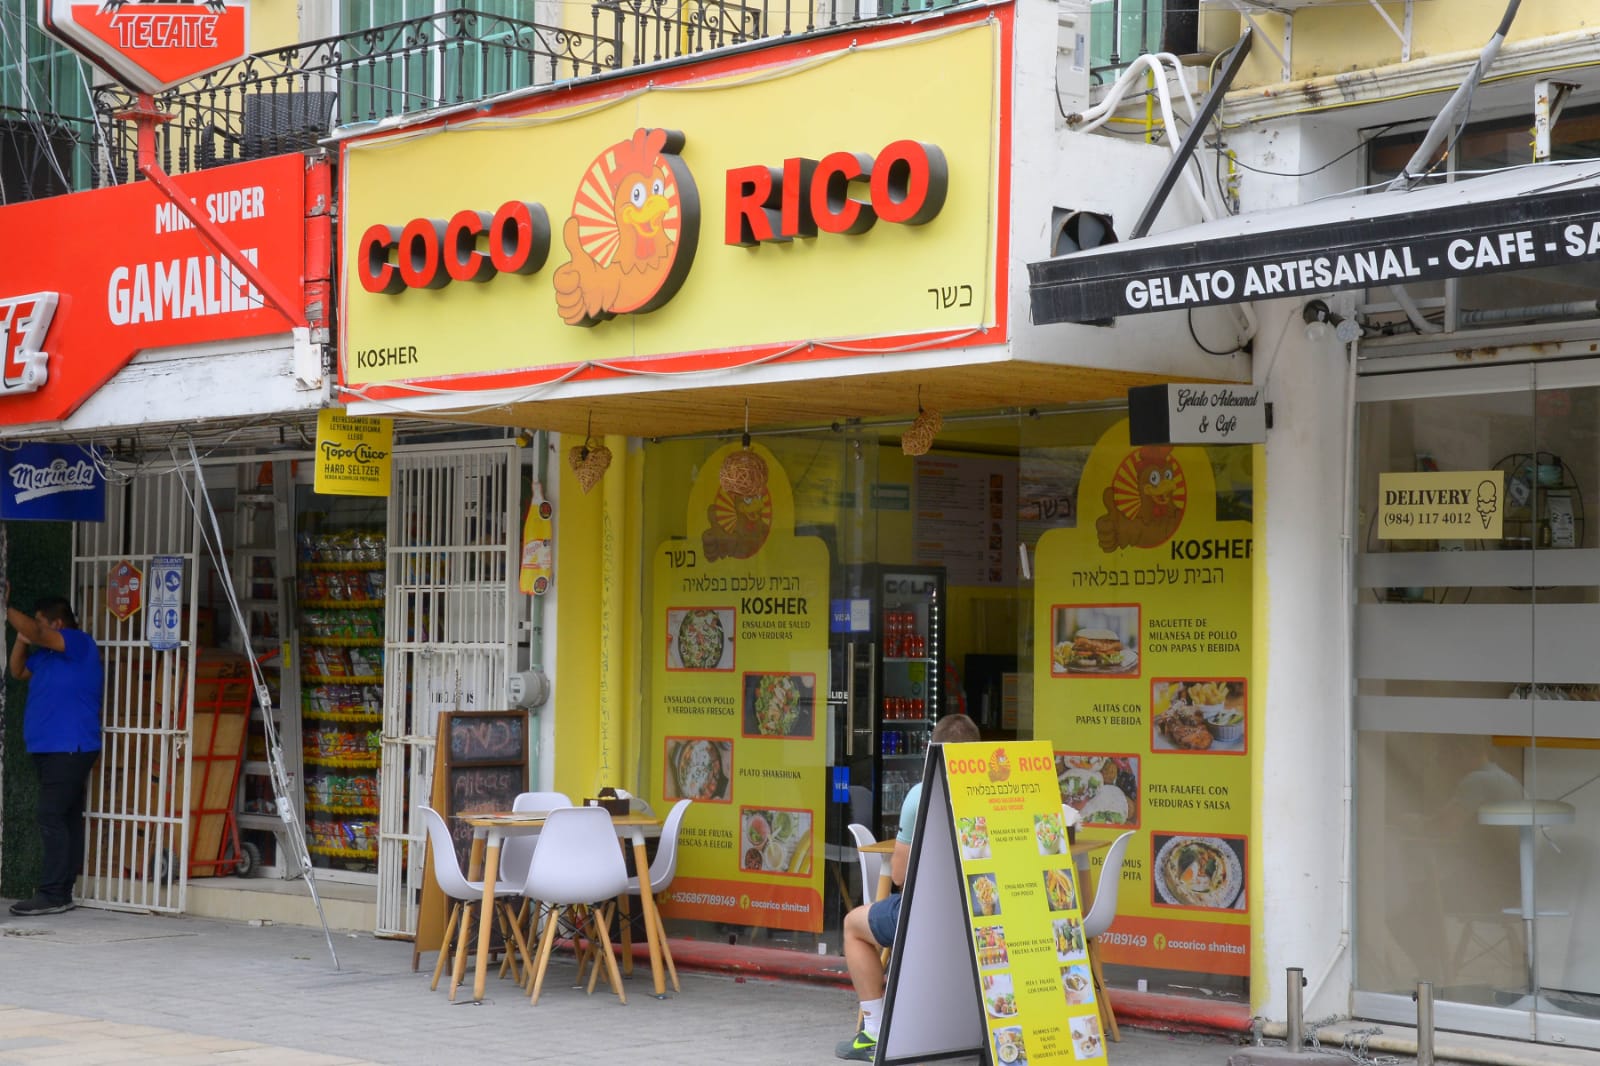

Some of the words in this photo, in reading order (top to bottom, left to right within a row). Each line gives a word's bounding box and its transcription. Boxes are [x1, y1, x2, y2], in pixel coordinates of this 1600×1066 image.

[110, 14, 218, 48] TECATE
[206, 186, 265, 224] SUPER
[358, 200, 551, 295] COCO
[725, 139, 948, 248] RICO
[1125, 269, 1235, 309] GELATO
[1243, 246, 1421, 297] ARTESANAL
[1427, 257, 1439, 266] -
[1447, 230, 1536, 271] CAFE
[108, 248, 265, 326] GAMALIEL
[928, 284, 973, 310] כשר
[357, 346, 418, 368] KOSHER
[1176, 389, 1209, 413] Gelato
[1211, 389, 1259, 407] Artesanal
[1199, 416, 1209, 433] &
[321, 440, 355, 461] Topo
[354, 443, 388, 464] Chico
[9, 458, 95, 490] Marinela
[325, 464, 345, 474] HARD
[348, 465, 380, 476] SELTZER
[1385, 489, 1472, 506] DELIVERY
[1384, 512, 1415, 527] (984)
[1417, 513, 1439, 525] 117
[1441, 512, 1472, 525] 4012
[665, 550, 696, 568] כשר
[731, 573, 766, 591] שלכם
[1134, 564, 1179, 586] שלכם
[1184, 567, 1224, 584] הבית
[769, 575, 800, 591] הבית
[741, 597, 808, 615] KOSHER
[742, 620, 776, 629] ENSALADA
[777, 621, 788, 629] DE
[1149, 619, 1193, 628] BAGUETTE
[1195, 618, 1207, 627] DE
[741, 631, 757, 640] CON
[759, 631, 793, 640] VERDURAS
[1149, 631, 1191, 640] MILANESA
[1193, 631, 1206, 640] DE
[1208, 630, 1237, 640] POLLO
[1149, 644, 1168, 653] CON
[1170, 644, 1197, 653] PAPAS
[1199, 643, 1205, 652] Y
[1207, 643, 1240, 653] BEBIDA
[664, 695, 696, 704] ENSALADA
[697, 696, 712, 704] CON
[713, 696, 735, 705] POLLO
[672, 706, 705, 715] VERDURAS
[706, 707, 735, 716] FRESCAS
[1093, 704, 1121, 713] ALITAS
[1122, 704, 1142, 713] CON
[1076, 715, 1101, 725] PAPAS
[1103, 716, 1108, 725] Y
[1110, 716, 1142, 726] BEBIDA
[739, 768, 761, 777] PLATO
[948, 758, 987, 775] COCO
[1018, 756, 1052, 772] RICO
[1149, 784, 1168, 794] PITA
[1170, 785, 1206, 795] FALAFEL
[1208, 786, 1229, 796] CON
[1149, 799, 1193, 809] VERDURAS
[1196, 800, 1201, 809] Y
[1203, 800, 1231, 810] SALSA
[698, 828, 708, 837] DE
[709, 829, 733, 838] FRUTAS
[704, 840, 709, 848] A
[709, 840, 733, 849] ELEGIR
[1122, 871, 1142, 881] PITA
[751, 900, 780, 910] cocorico
[781, 902, 810, 913] shnitzel
[1168, 939, 1206, 951] cocorico
[1208, 941, 1246, 954] shnitzel
